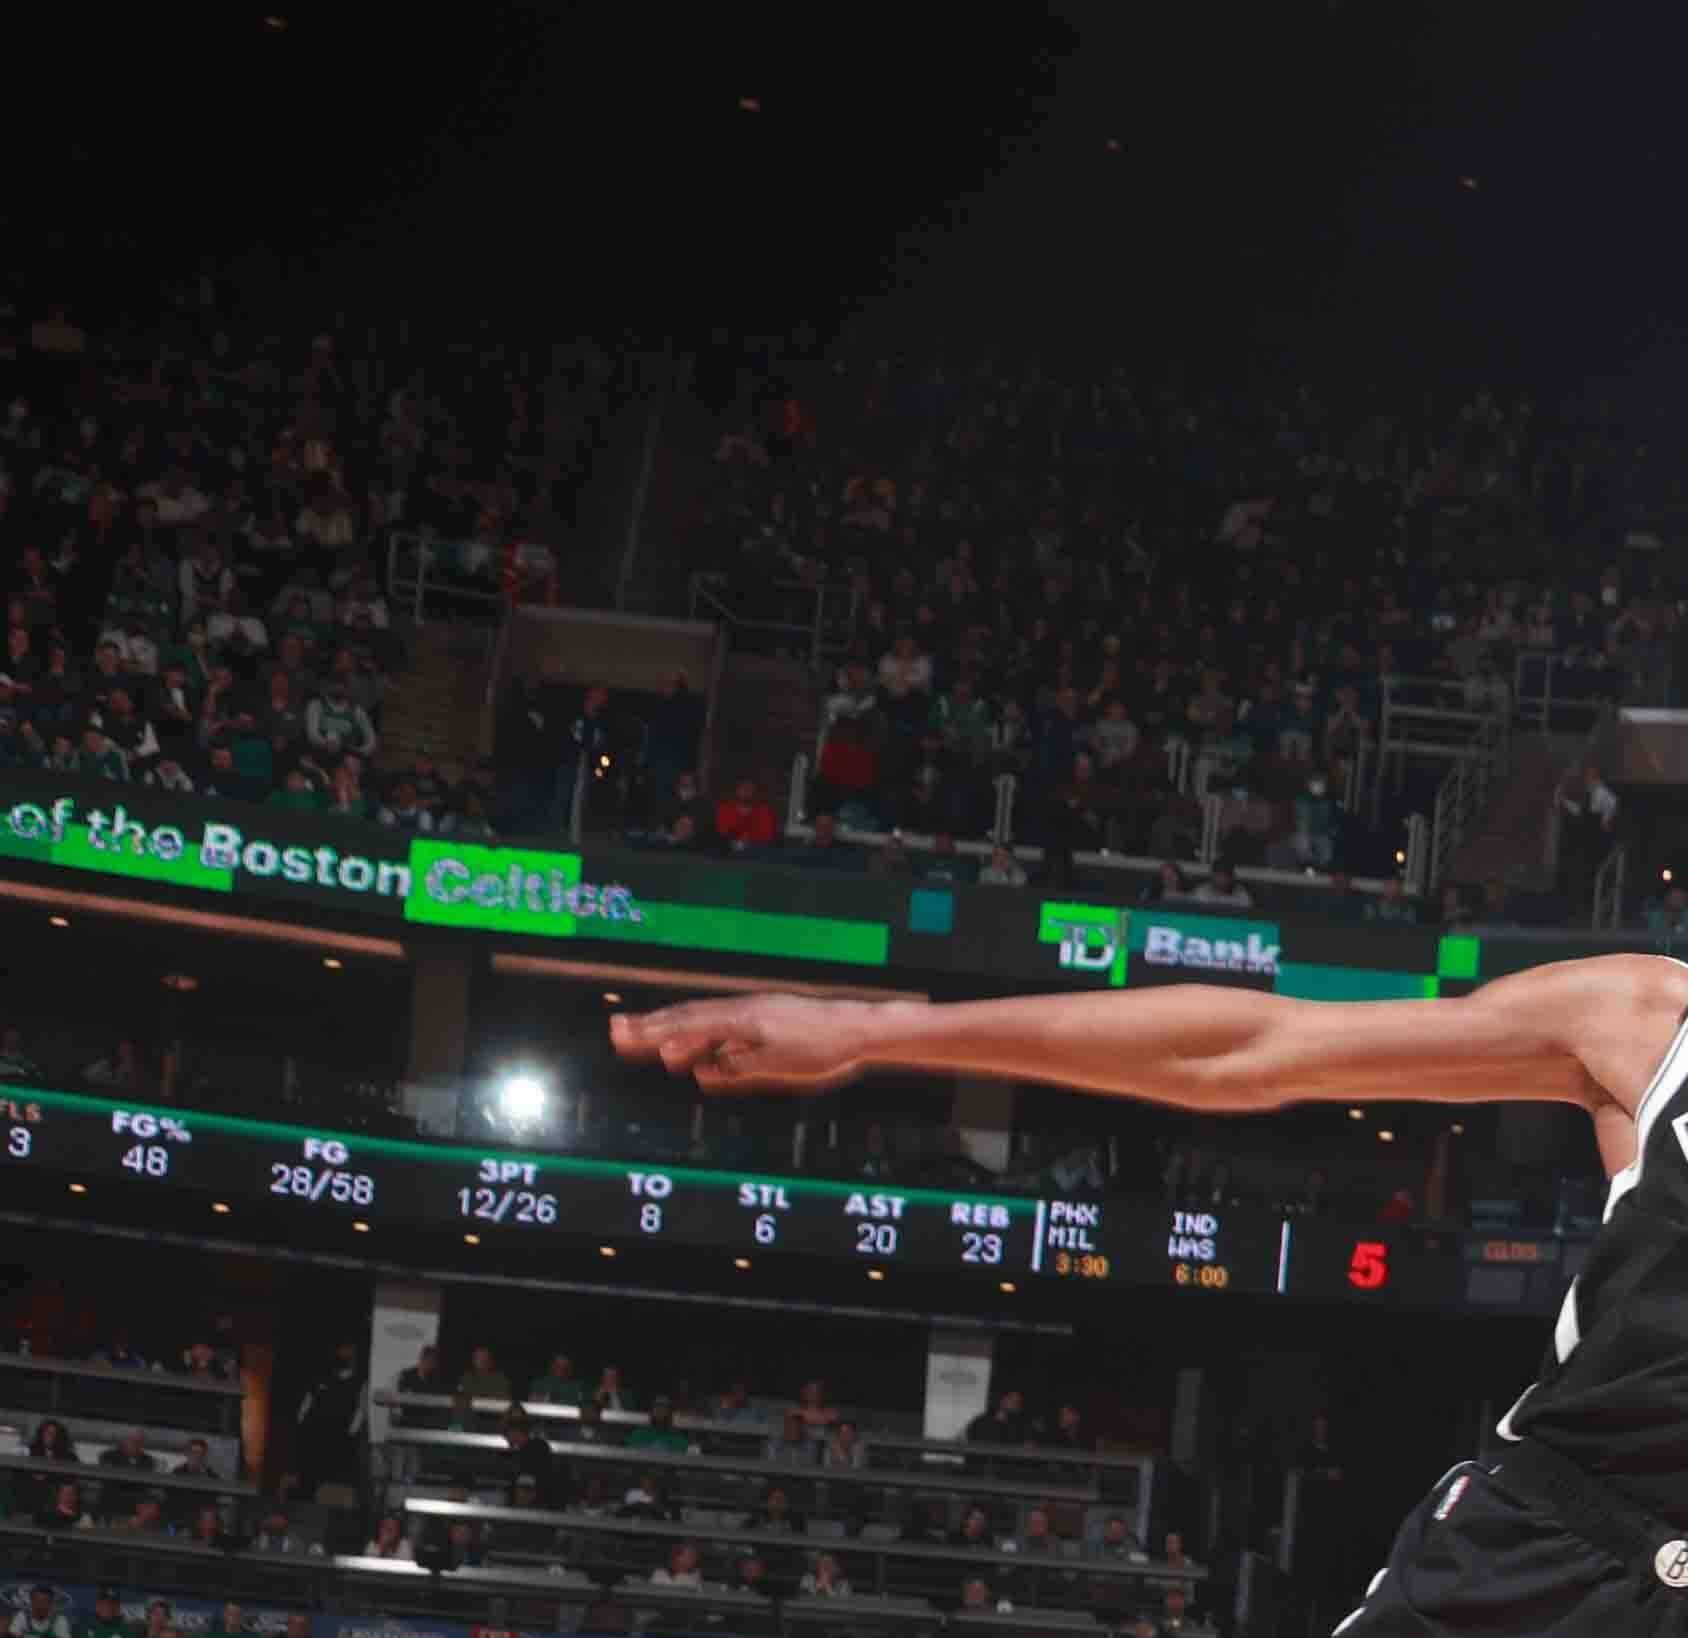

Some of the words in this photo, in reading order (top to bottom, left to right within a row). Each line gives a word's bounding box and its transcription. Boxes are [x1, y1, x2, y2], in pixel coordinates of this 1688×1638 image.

[10, 799, 75, 842] of
[85, 805, 185, 862] the
[200, 822, 412, 896] Boston
[425, 856, 645, 923] Celtics.
[1144, 925, 1281, 975] Bank
[111, 1109, 192, 1142] FG%
[7, 1126, 32, 1157] 3
[303, 1137, 349, 1165] FG
[121, 1145, 168, 1177] 48
[477, 1158, 540, 1184] 3PT
[269, 1163, 375, 1205] 28/58
[628, 1172, 673, 1199] TO
[738, 1182, 790, 1210] STL
[457, 1187, 557, 1224] 12/26
[639, 1203, 662, 1234] 8
[844, 1192, 909, 1219] AST
[950, 1201, 1010, 1229] REB
[754, 1213, 776, 1244] 6
[855, 1223, 898, 1255] 20
[1047, 1226, 1096, 1252] MIL
[1172, 1211, 1219, 1236] IND
[1168, 1236, 1217, 1260] WAS
[1174, 1262, 1229, 1290] 6:00
[1348, 1241, 1389, 1289] 5
